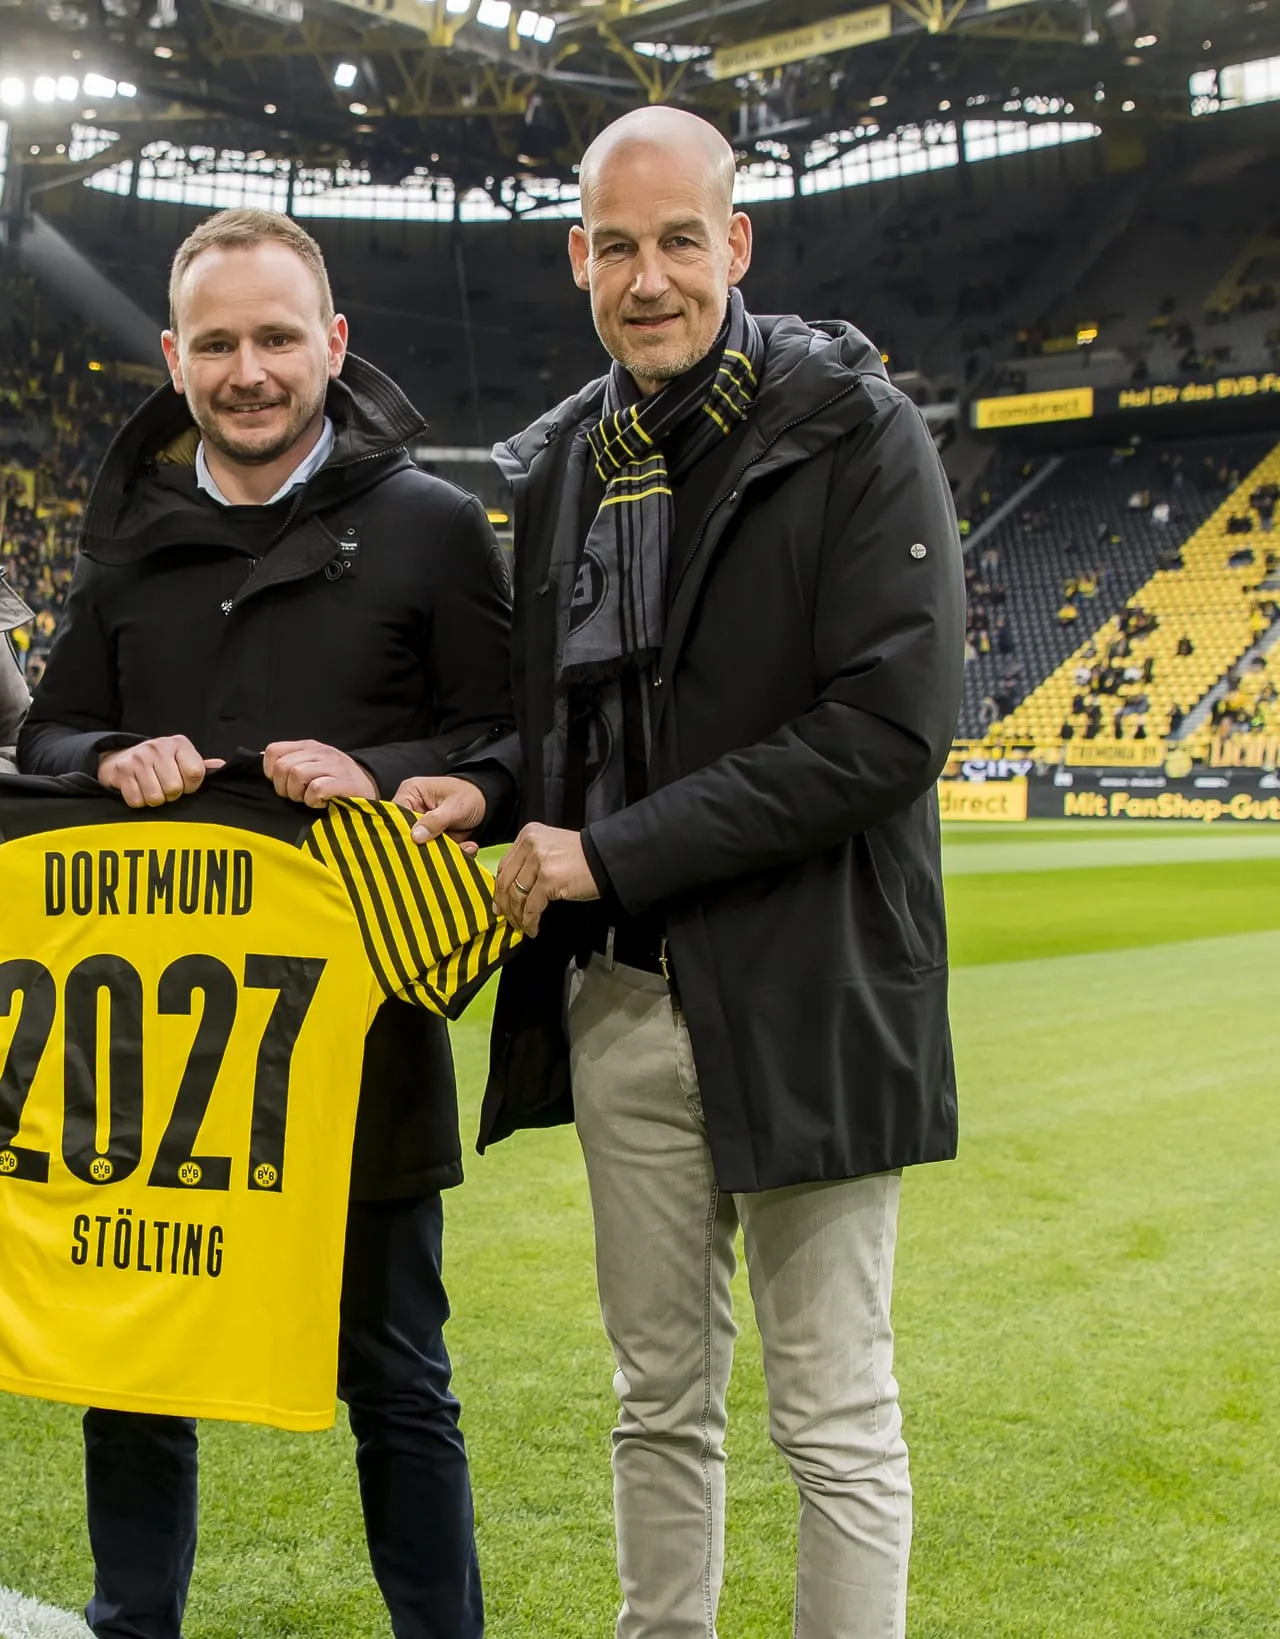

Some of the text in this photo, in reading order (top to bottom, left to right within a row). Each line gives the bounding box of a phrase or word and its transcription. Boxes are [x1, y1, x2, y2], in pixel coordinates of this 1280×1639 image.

[1064, 791, 1108, 817] Mit
[45, 848, 253, 917] DORTMUND
[0, 1153, 15, 1167] BVB
[93, 1161, 111, 1174] BVB
[181, 1164, 199, 1178] BVB
[257, 1166, 275, 1180] BVB
[71, 1208, 224, 1277] STÖLTING
